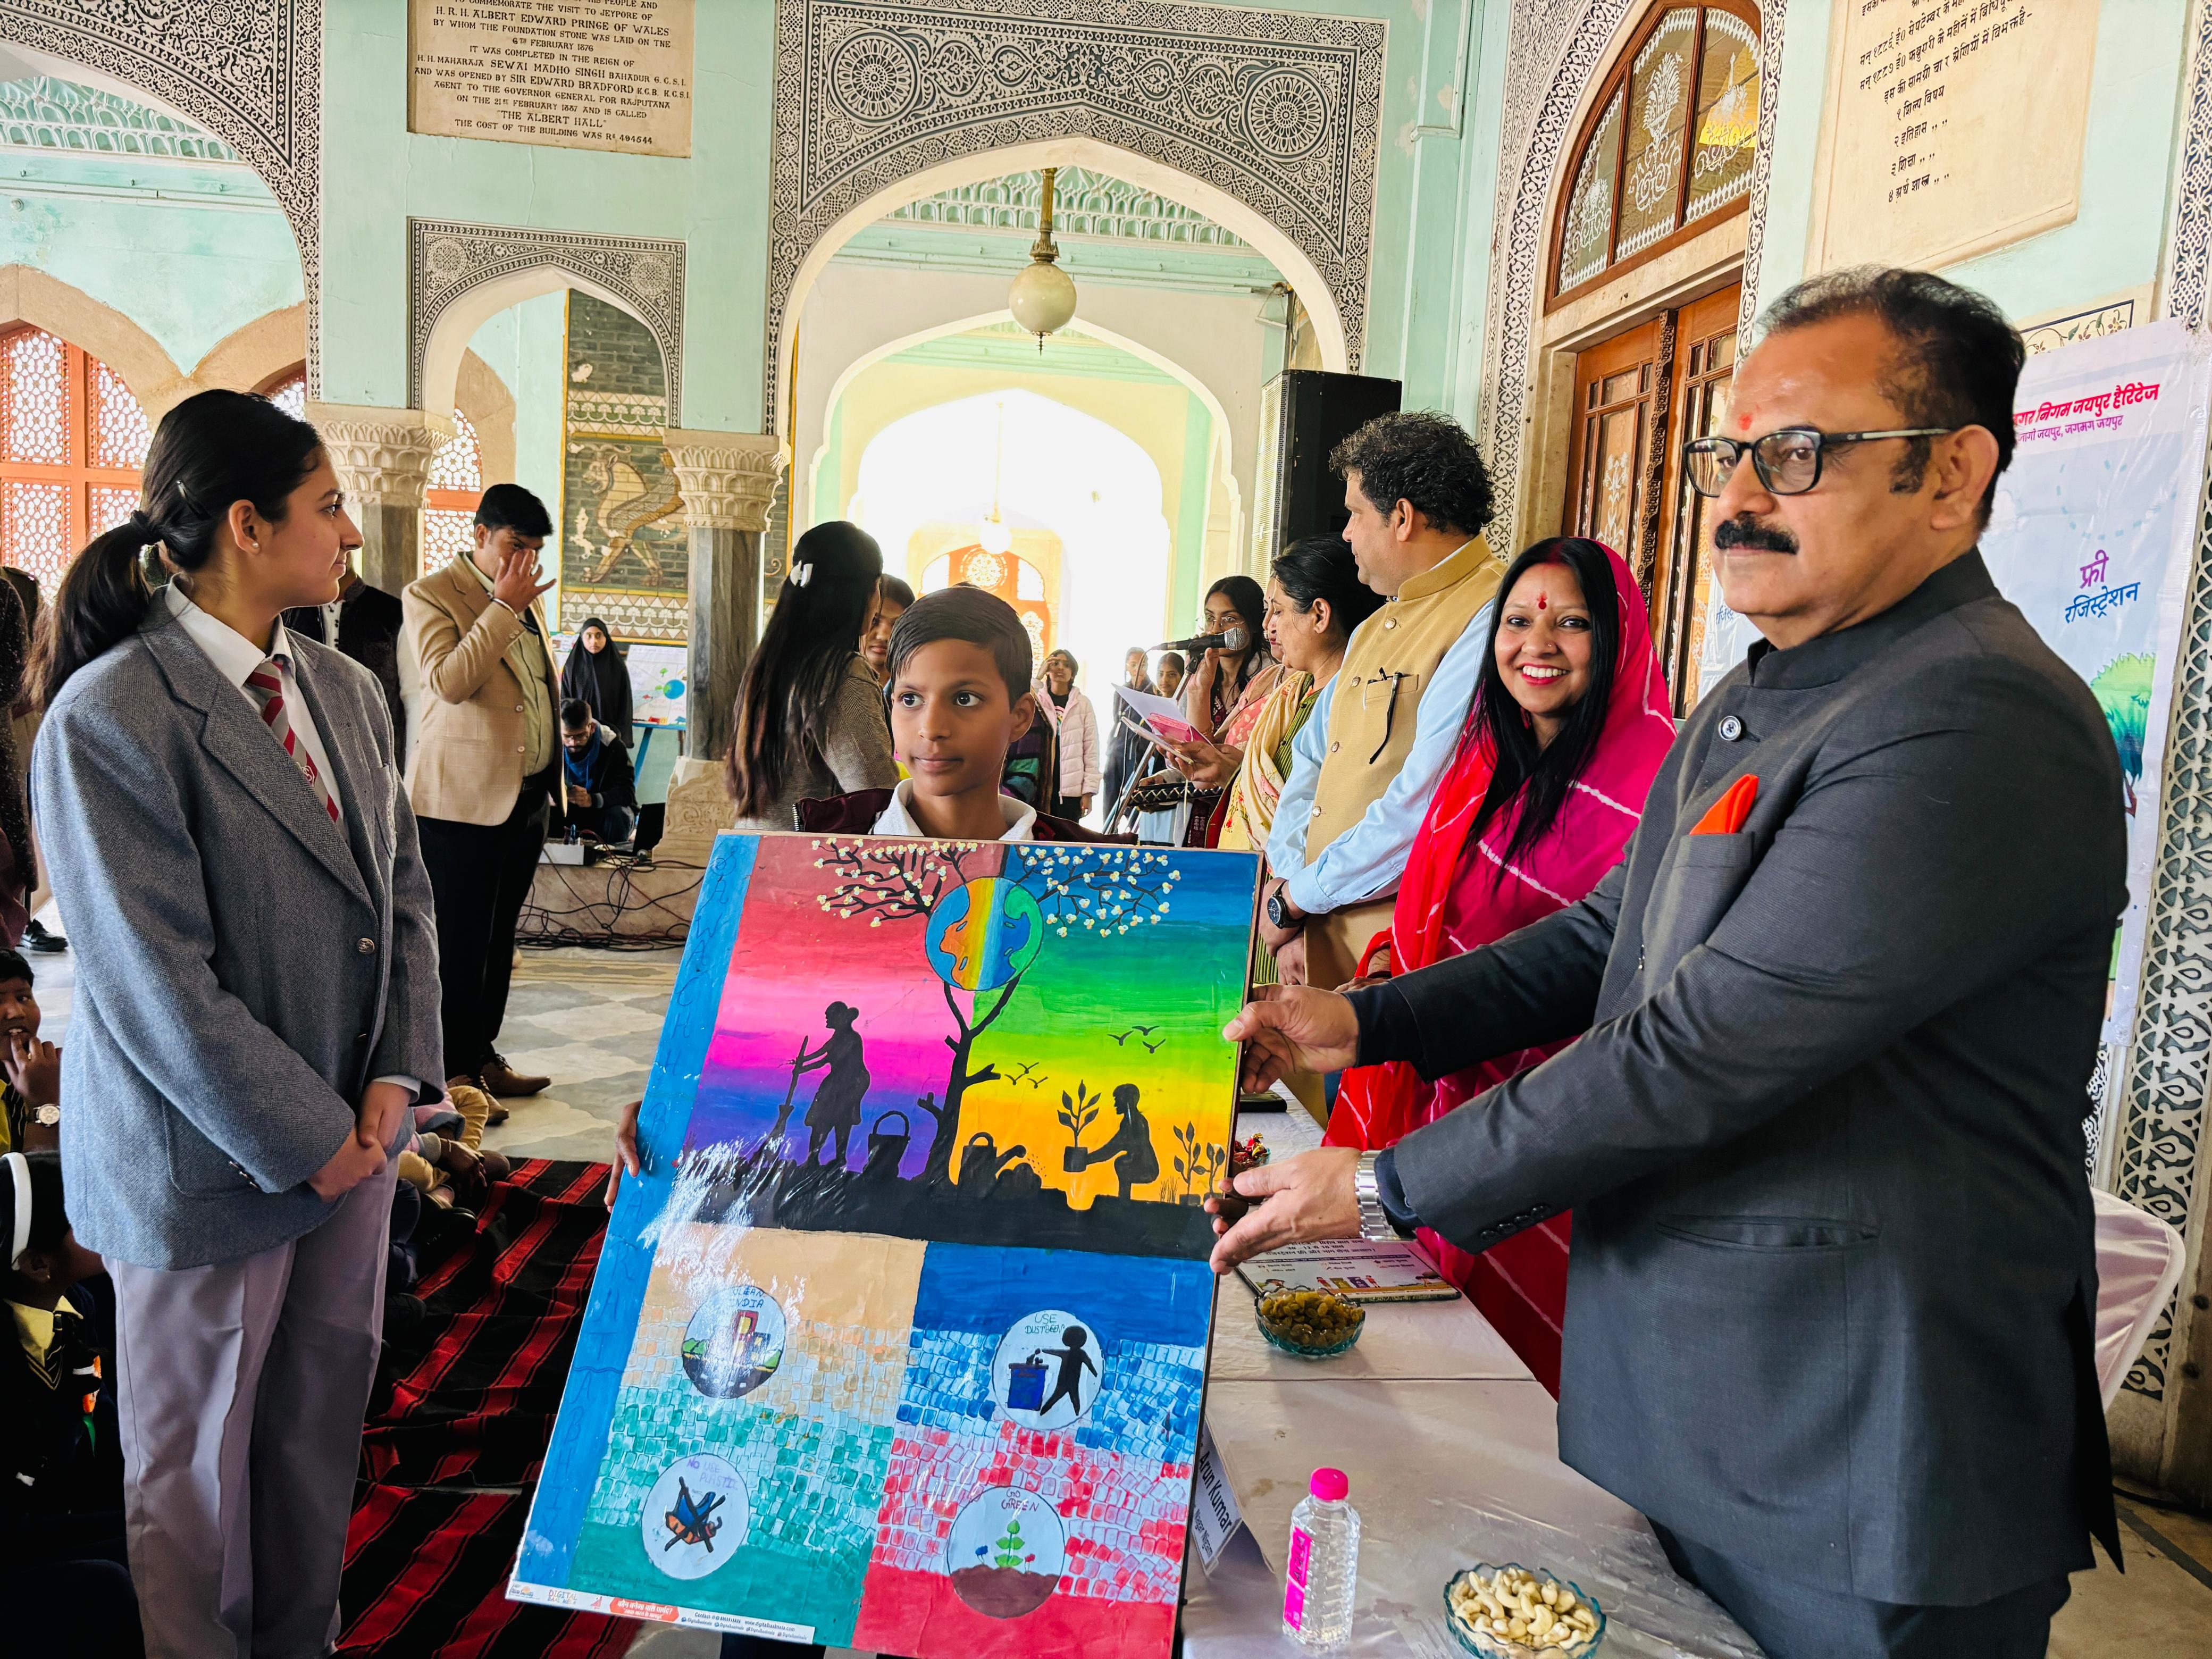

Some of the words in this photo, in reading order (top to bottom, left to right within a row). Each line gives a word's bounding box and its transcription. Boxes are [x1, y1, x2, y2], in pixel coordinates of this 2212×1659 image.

[536, 3, 554, 11] THE
[558, 5, 580, 14] VISIT
[600, 9, 638, 20] JEYPORE
[641, 13, 653, 21] OF
[473, 9, 516, 21] ALBERT
[521, 14, 566, 27] EDWARD
[614, 23, 627, 32] OF
[633, 24, 670, 36] WALES
[449, 20, 476, 29] WHOM
[480, 23, 498, 31] THE
[502, 25, 556, 37] FOUNDATION
[560, 30, 588, 40] STONE
[591, 33, 610, 42] WAS
[614, 36, 634, 45] LAID
[638, 38, 649, 46] ON
[1938, 28, 1945, 44] के
[1982, 28, 1990, 44] में
[531, 39, 574, 50] FEBRUARY
[577, 44, 594, 52] 1876
[482, 46, 501, 55] WAS
[505, 48, 555, 60] COMPLETED
[559, 53, 568, 62] IN
[572, 55, 590, 63] THE
[593, 57, 620, 66] REIGN
[438, 56, 484, 68] MAHARAJA
[490, 59, 528, 71] SEWAI
[534, 63, 570, 75] MADHO
[575, 67, 606, 78] SINGH
[609, 72, 650, 83] BAHADUR
[458, 71, 492, 80] OPENED
[510, 74, 526, 83] SIR
[530, 76, 574, 88] EDWARD
[579, 81, 634, 94] BRADFORD
[434, 81, 462, 90] AGENT
[483, 85, 500, 93] THE
[504, 87, 551, 98] GOVERNOR
[555, 91, 596, 102] GENERAL
[599, 95, 617, 104] FOR
[621, 97, 671, 109] RAJPUTANA
[472, 96, 491, 104] THE
[513, 99, 557, 111] FEBRUARY
[582, 106, 600, 114] AND
[1924, 85, 1945, 106] विषय
[527, 112, 569, 124] ALBERT
[455, 119, 472, 127] THE
[540, 127, 578, 137] BUILDING
[582, 131, 602, 139] WAS
[1901, 121, 1928, 145] इतिहास
[2035, 402, 2073, 423] निगम
[2073, 393, 2112, 417] जयपुर
[2113, 382, 2160, 409] हैरिटेज
[2038, 426, 2063, 440] जयपुर,
[2065, 421, 2094, 434] जगमग
[2096, 415, 2124, 431] जयपुर
[2080, 549, 2109, 589] फ्री
[2065, 582, 2141, 624] रजिस्ट्रेशन
[733, 1298, 764, 1308] NDIA
[1034, 1313, 1057, 1324] USE
[686, 1457, 700, 1469] NO
[1006, 1488, 1020, 1498] GO
[1200, 1451, 1216, 1489] Arun
[1208, 1480, 1231, 1532] Kumar
[1001, 1498, 1039, 1512] GREEN
[548, 1589, 577, 1600] DIGITAL
